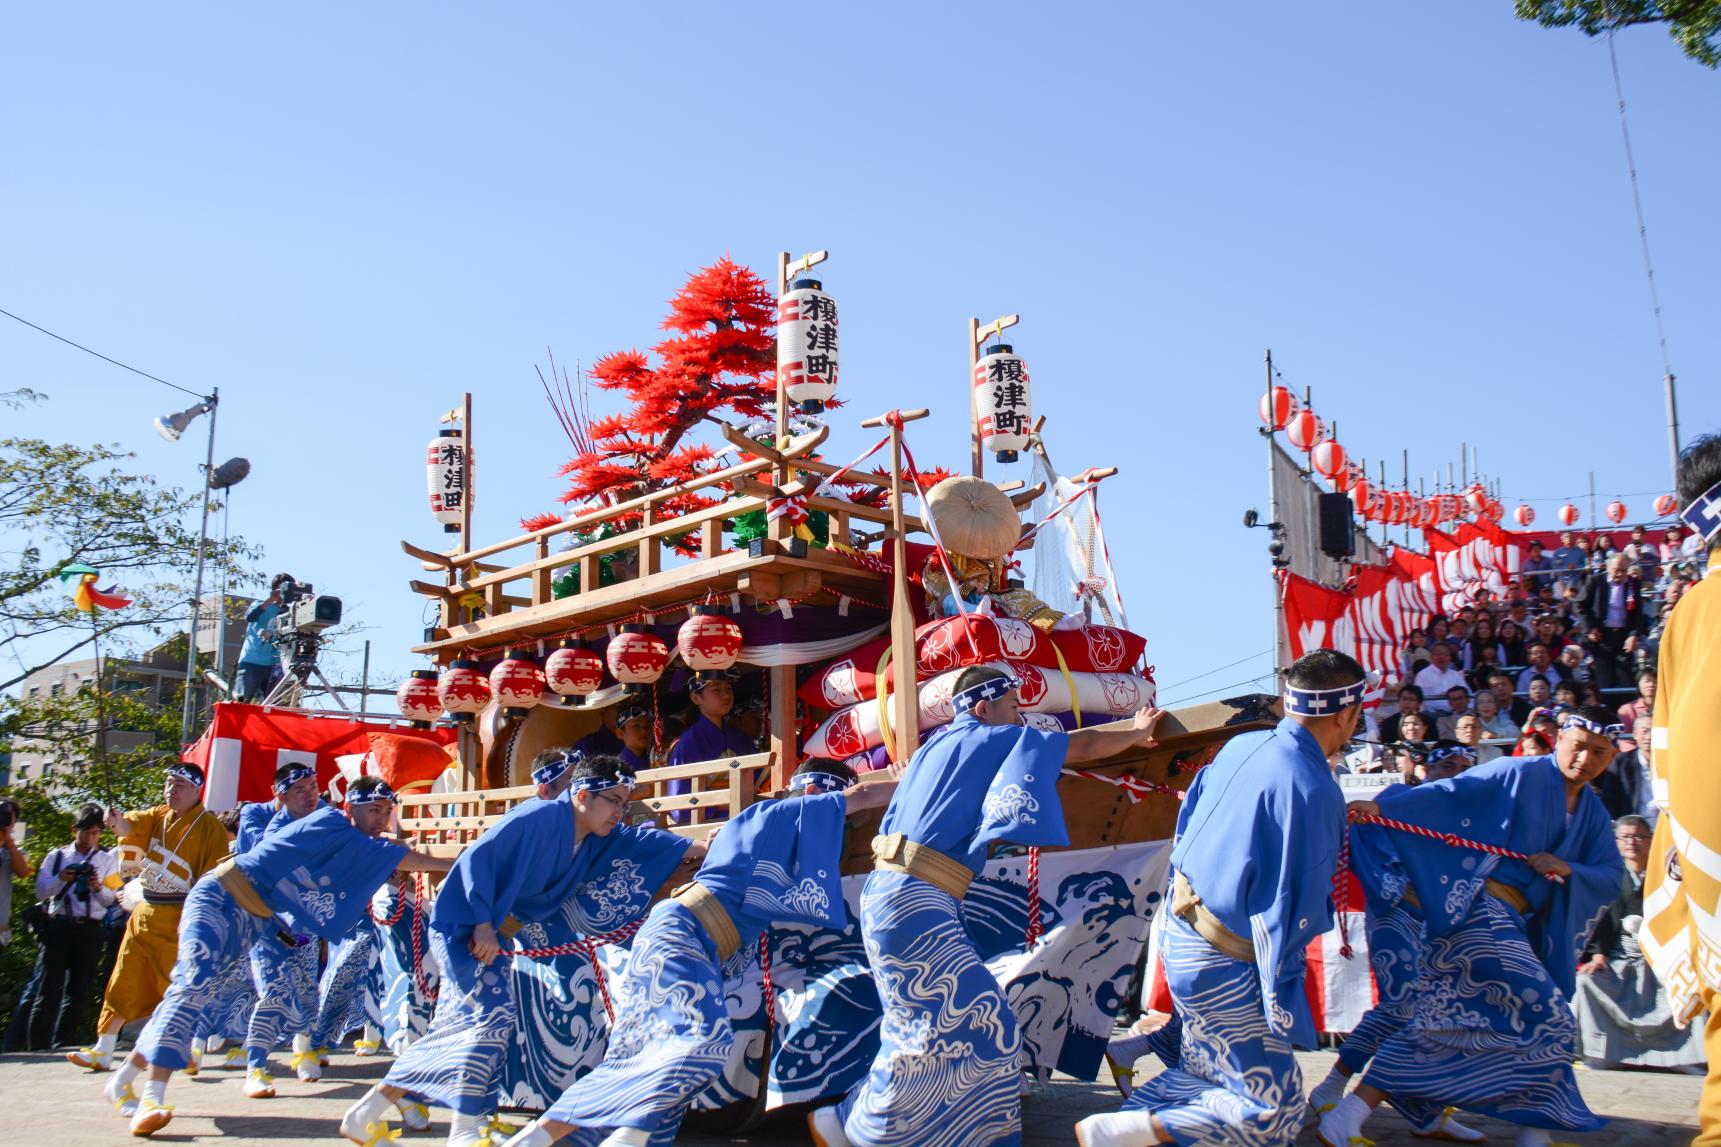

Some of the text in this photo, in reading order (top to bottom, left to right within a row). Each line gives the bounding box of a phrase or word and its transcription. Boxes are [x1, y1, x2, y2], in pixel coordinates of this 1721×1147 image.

[803, 294, 838, 384] 榎津町
[989, 359, 1026, 436] 榎津町
